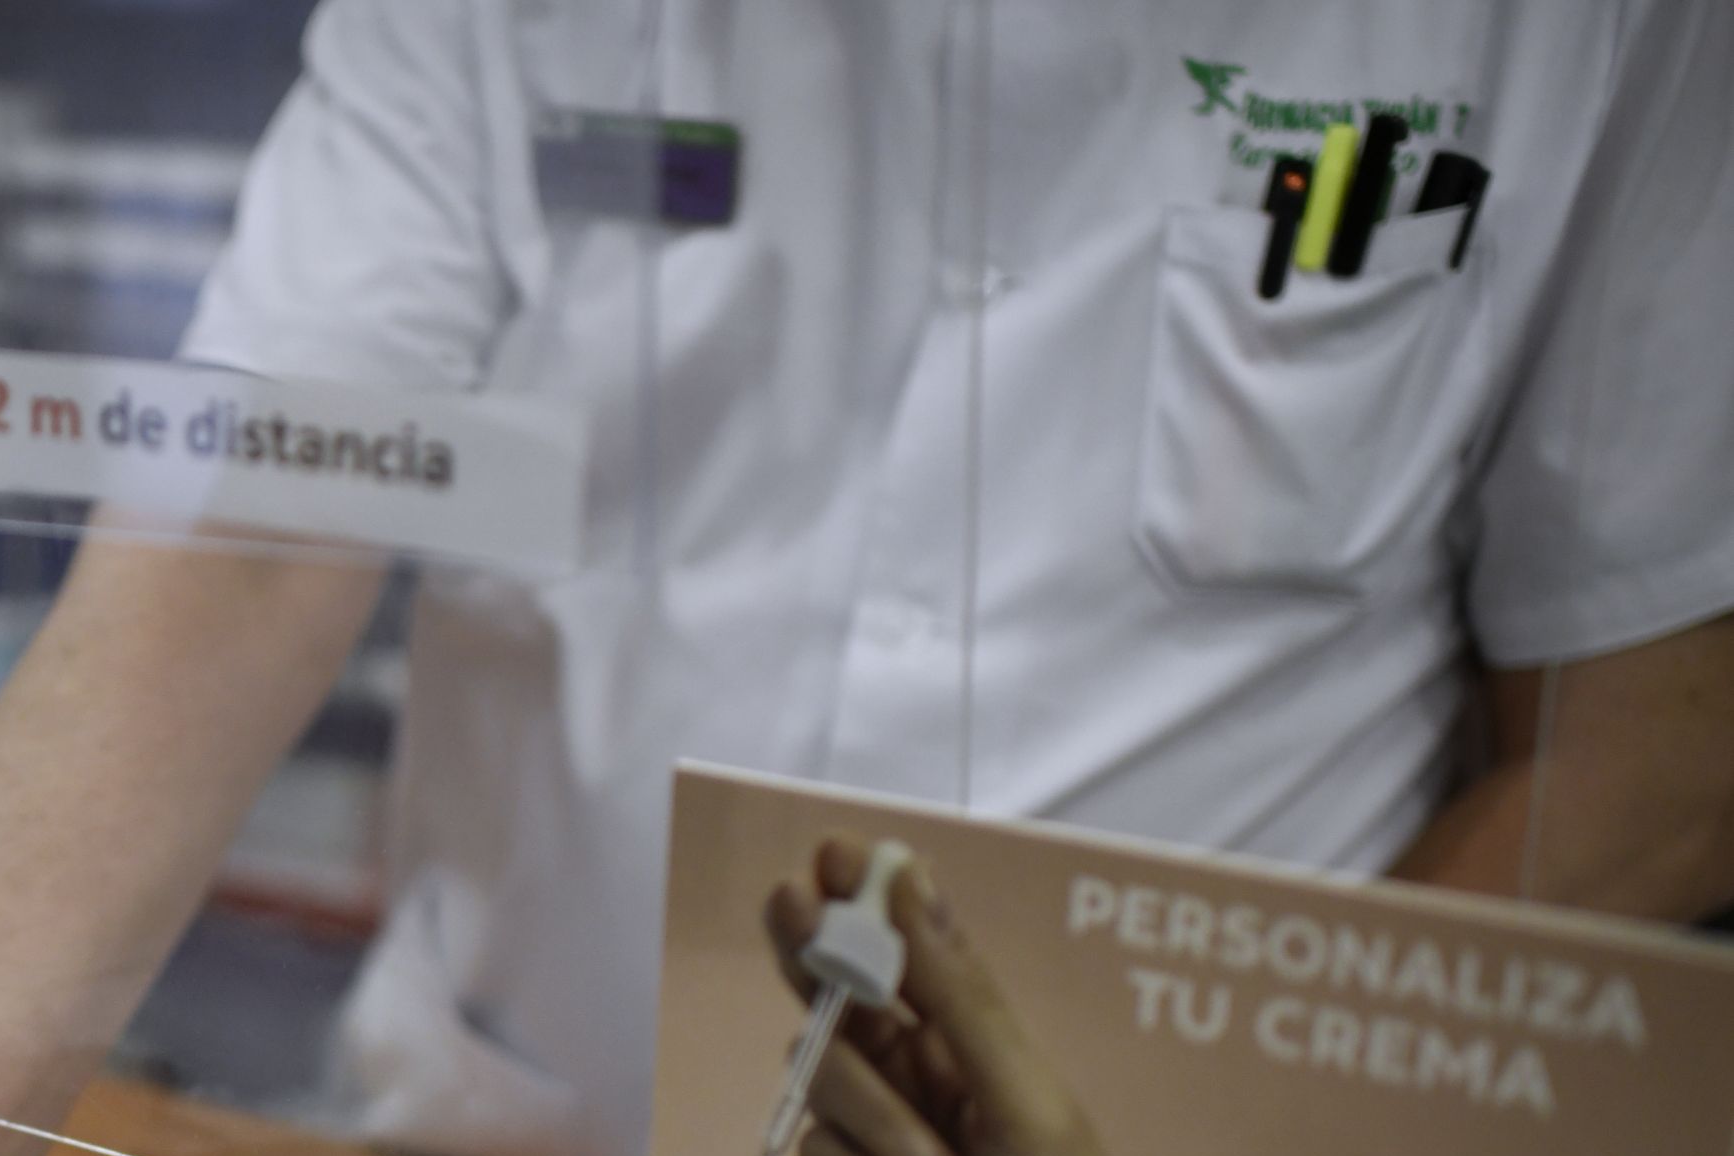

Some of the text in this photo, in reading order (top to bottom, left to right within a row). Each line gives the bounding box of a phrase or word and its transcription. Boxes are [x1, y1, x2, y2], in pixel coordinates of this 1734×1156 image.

[30, 399, 83, 442] m
[97, 389, 164, 451] de
[187, 399, 455, 491] distancia
[1067, 873, 1648, 1050] PERSONALIZA
[1127, 965, 1558, 1116] TU CREMA
